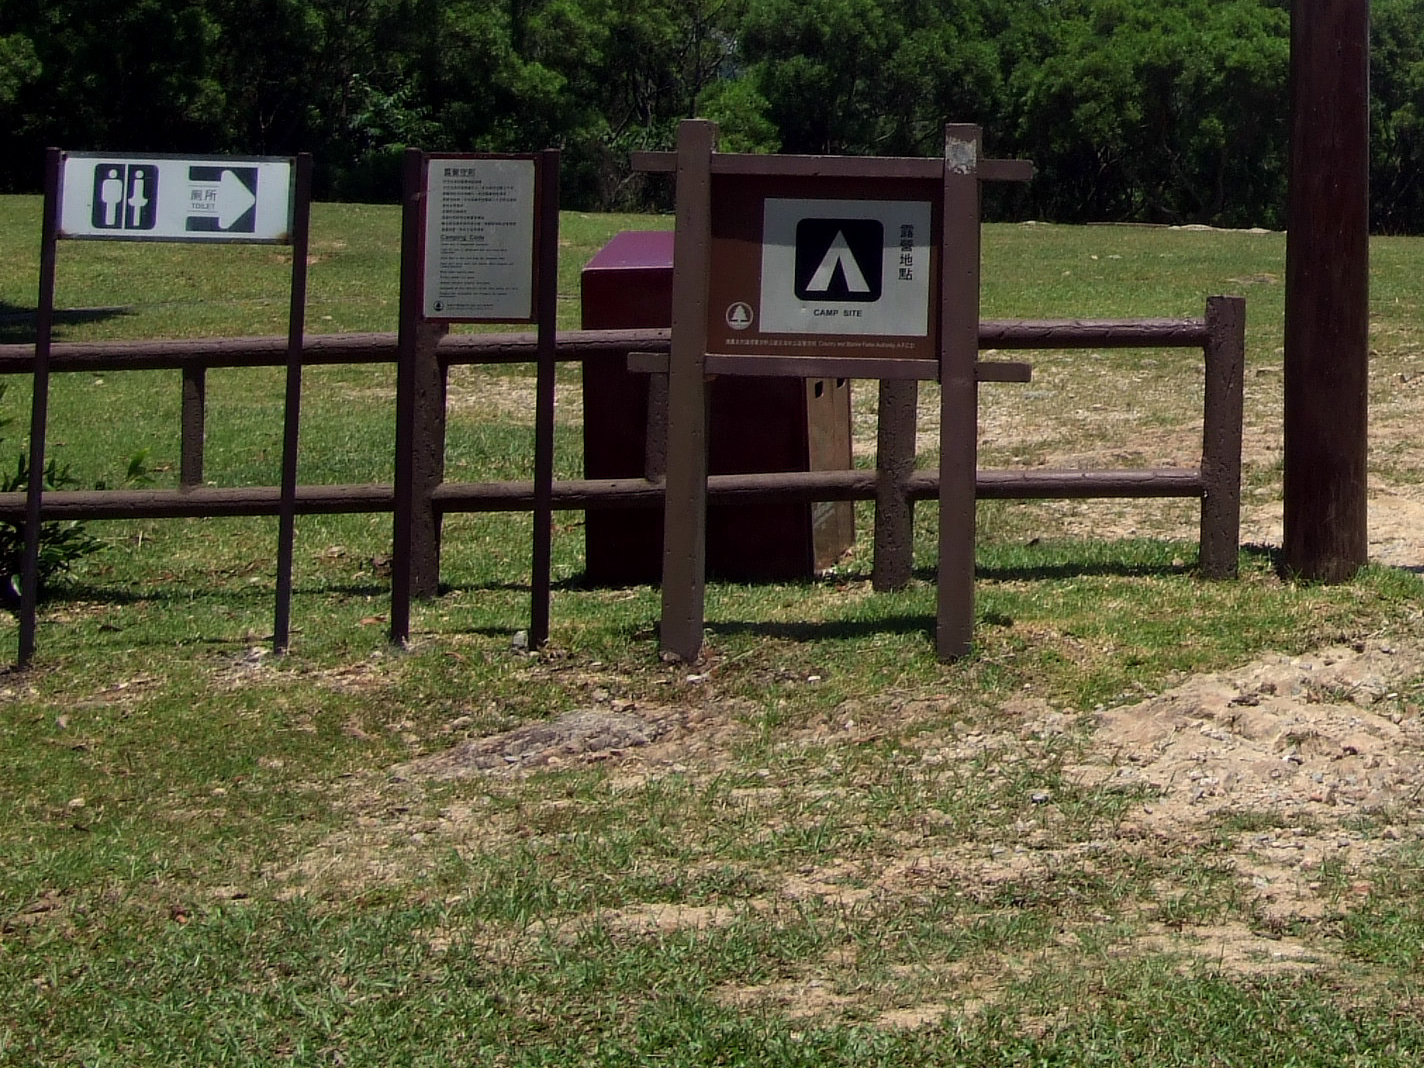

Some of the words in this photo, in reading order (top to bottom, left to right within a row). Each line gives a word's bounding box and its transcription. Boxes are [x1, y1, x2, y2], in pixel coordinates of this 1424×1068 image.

[899, 224, 914, 280] 露營地點
[813, 309, 839, 317] CAMP
[843, 309, 863, 318] SITE
